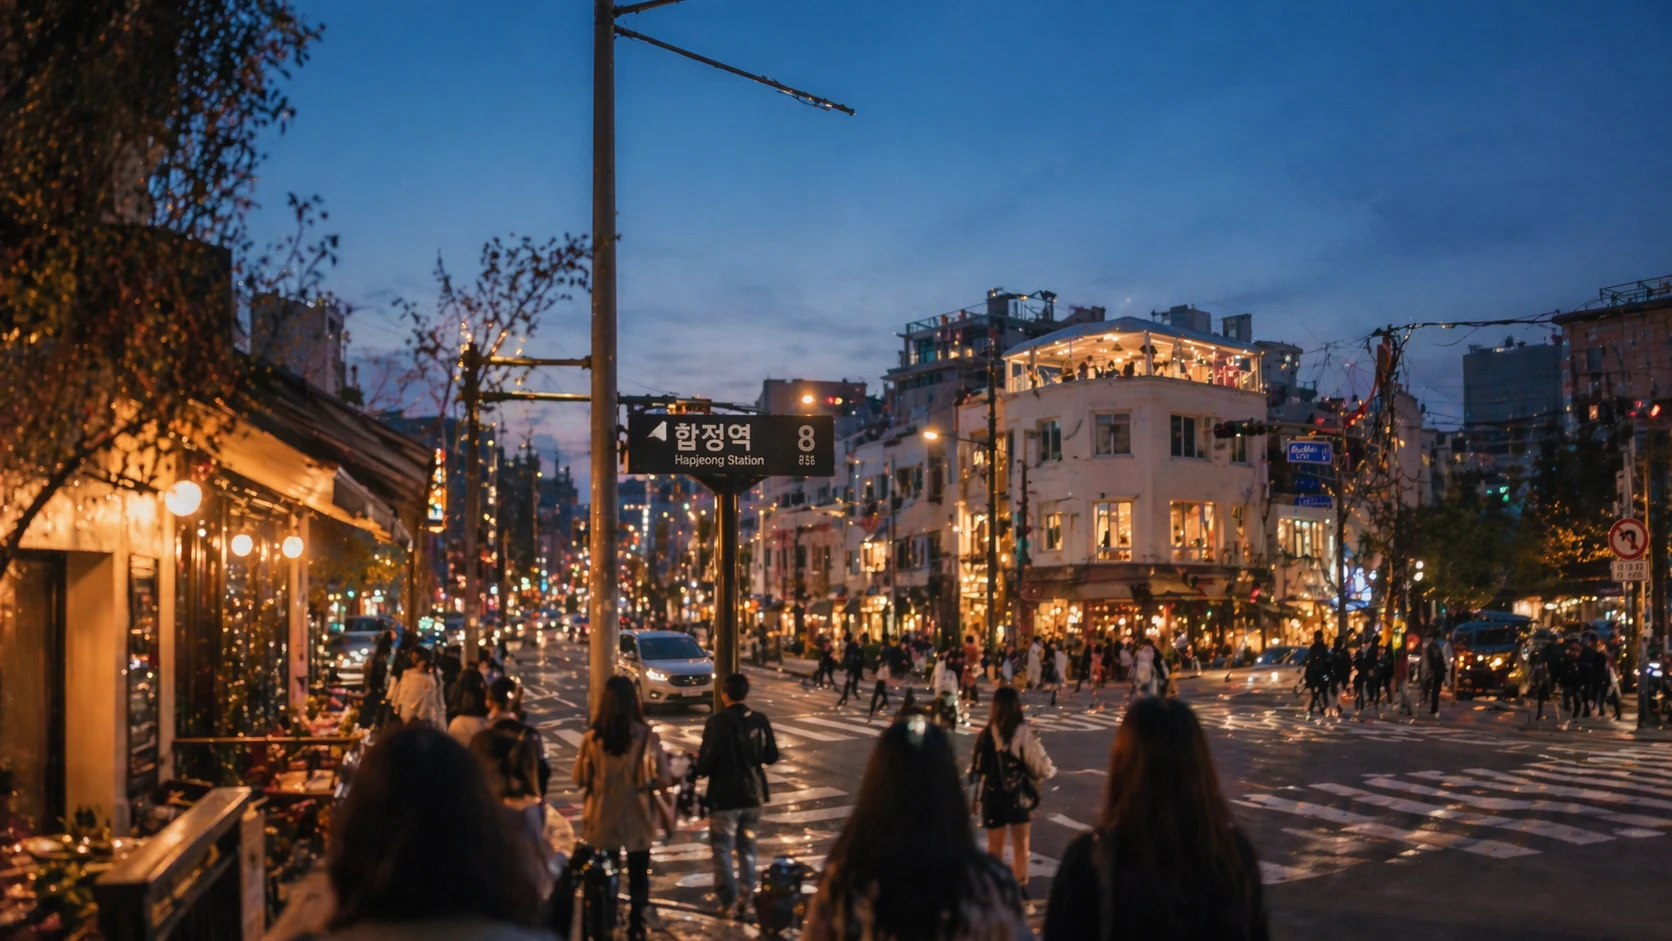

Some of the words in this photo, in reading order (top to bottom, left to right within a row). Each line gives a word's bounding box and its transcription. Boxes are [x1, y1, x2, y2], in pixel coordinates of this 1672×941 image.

[675, 422, 751, 452] 합정역
[797, 425, 816, 453] 8
[675, 454, 725, 468] Hapjeong
[727, 454, 765, 467] Station
